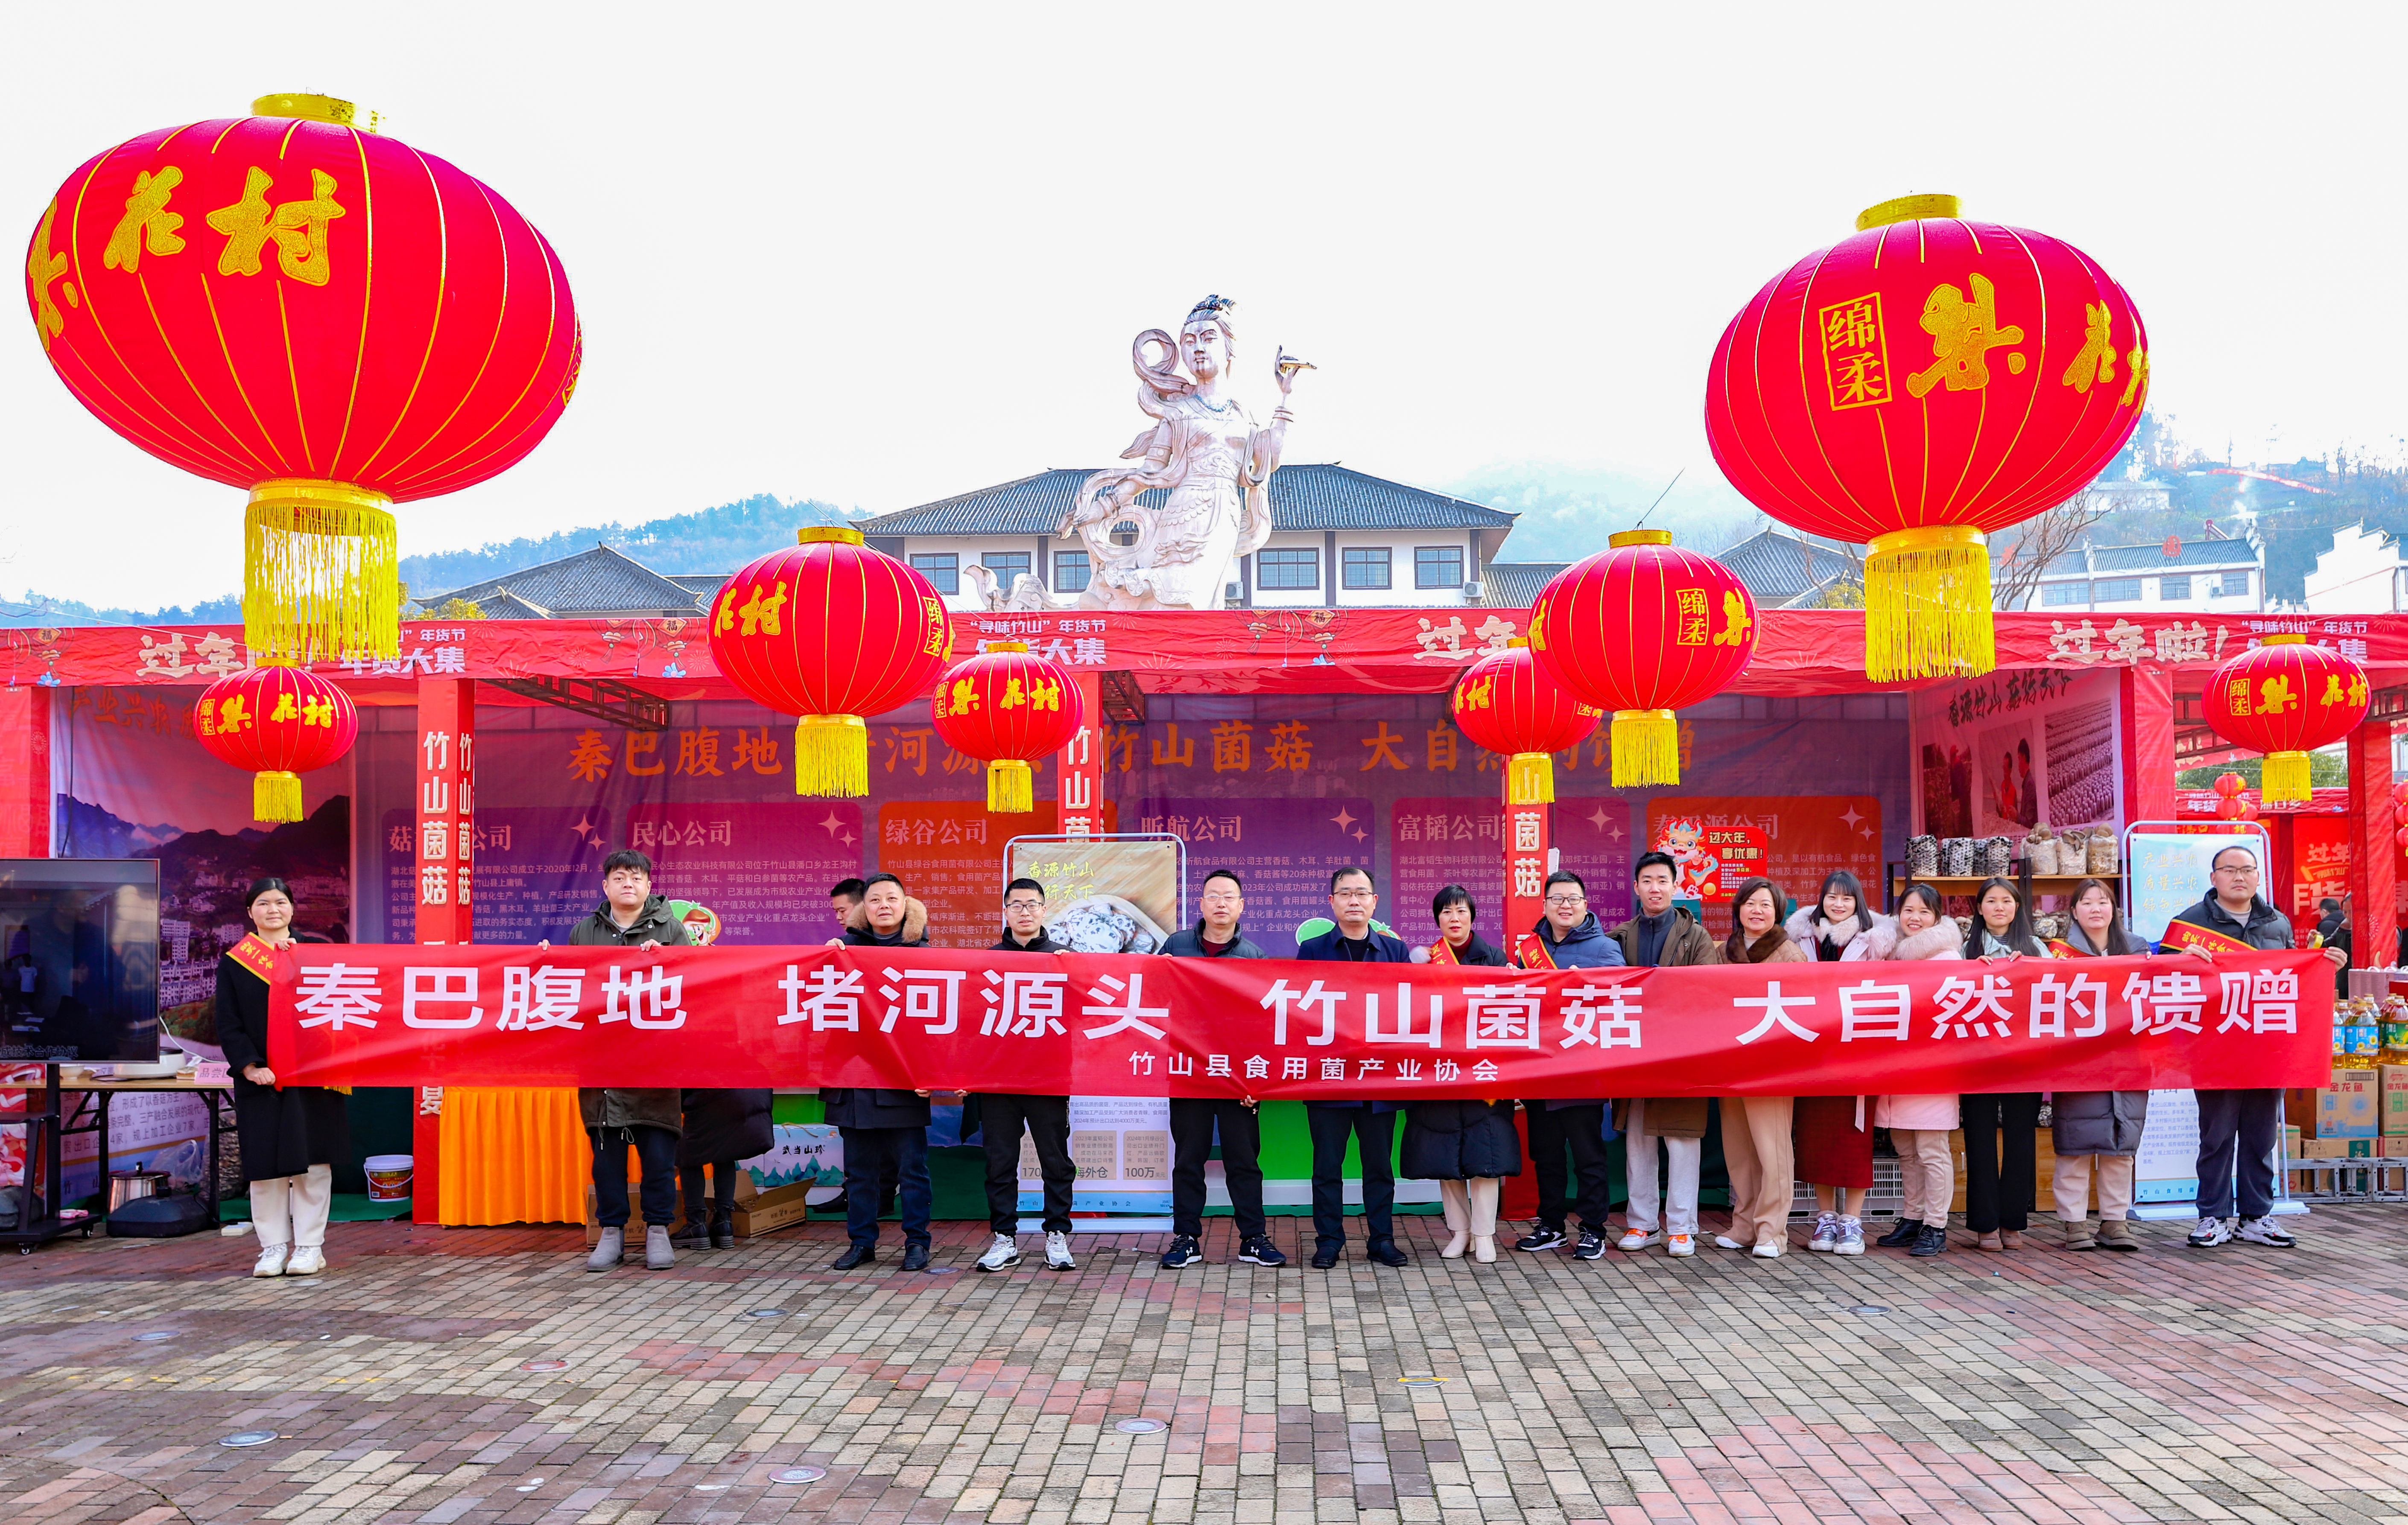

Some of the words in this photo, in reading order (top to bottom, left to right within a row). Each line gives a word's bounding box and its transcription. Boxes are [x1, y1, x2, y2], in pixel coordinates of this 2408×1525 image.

[1826, 302, 1885, 404] 绵柔
[970, 619, 1050, 633] “寻味竹山”
[1059, 620, 1106, 633] 年货节
[1682, 592, 1707, 644] 绵柔
[2241, 620, 2316, 634] “寻味竹山”
[2324, 620, 2367, 634] 年货节
[420, 628, 466, 642] 年货节
[935, 682, 947, 718] 绵柔
[2231, 679, 2249, 714] 绵柔
[201, 699, 215, 735] 绵柔
[568, 725, 783, 782] 秦巴腹地
[1104, 719, 1313, 773] 竹山菌菇
[422, 731, 450, 905] 竹山菌菇
[458, 732, 473, 905] 竹山菌菇
[885, 818, 988, 846] 绿谷公司
[1398, 814, 1499, 842] 富韬公司
[632, 819, 732, 847] 民心公司
[1709, 831, 1751, 844] 过大年，
[1026, 860, 1094, 879] 香源竹山
[651, 887, 833, 897] 政府的坚强领导下，已发展成为市级农业产业化
[717, 913, 830, 923] 市农业产业化重点龙头企业”
[725, 927, 754, 936] 等荣誉。
[295, 963, 687, 1032] 秦巴腹地
[777, 964, 1169, 1040] 堵河源头
[1260, 979, 1643, 1050] 竹山菌菇
[1733, 968, 2299, 1045] 大自然的馈赠
[1128, 1051, 1499, 1082] 竹山县食用菌产业协会
[782, 1144, 825, 1155] 武当山珍
[1125, 1167, 1155, 1178] 100万
